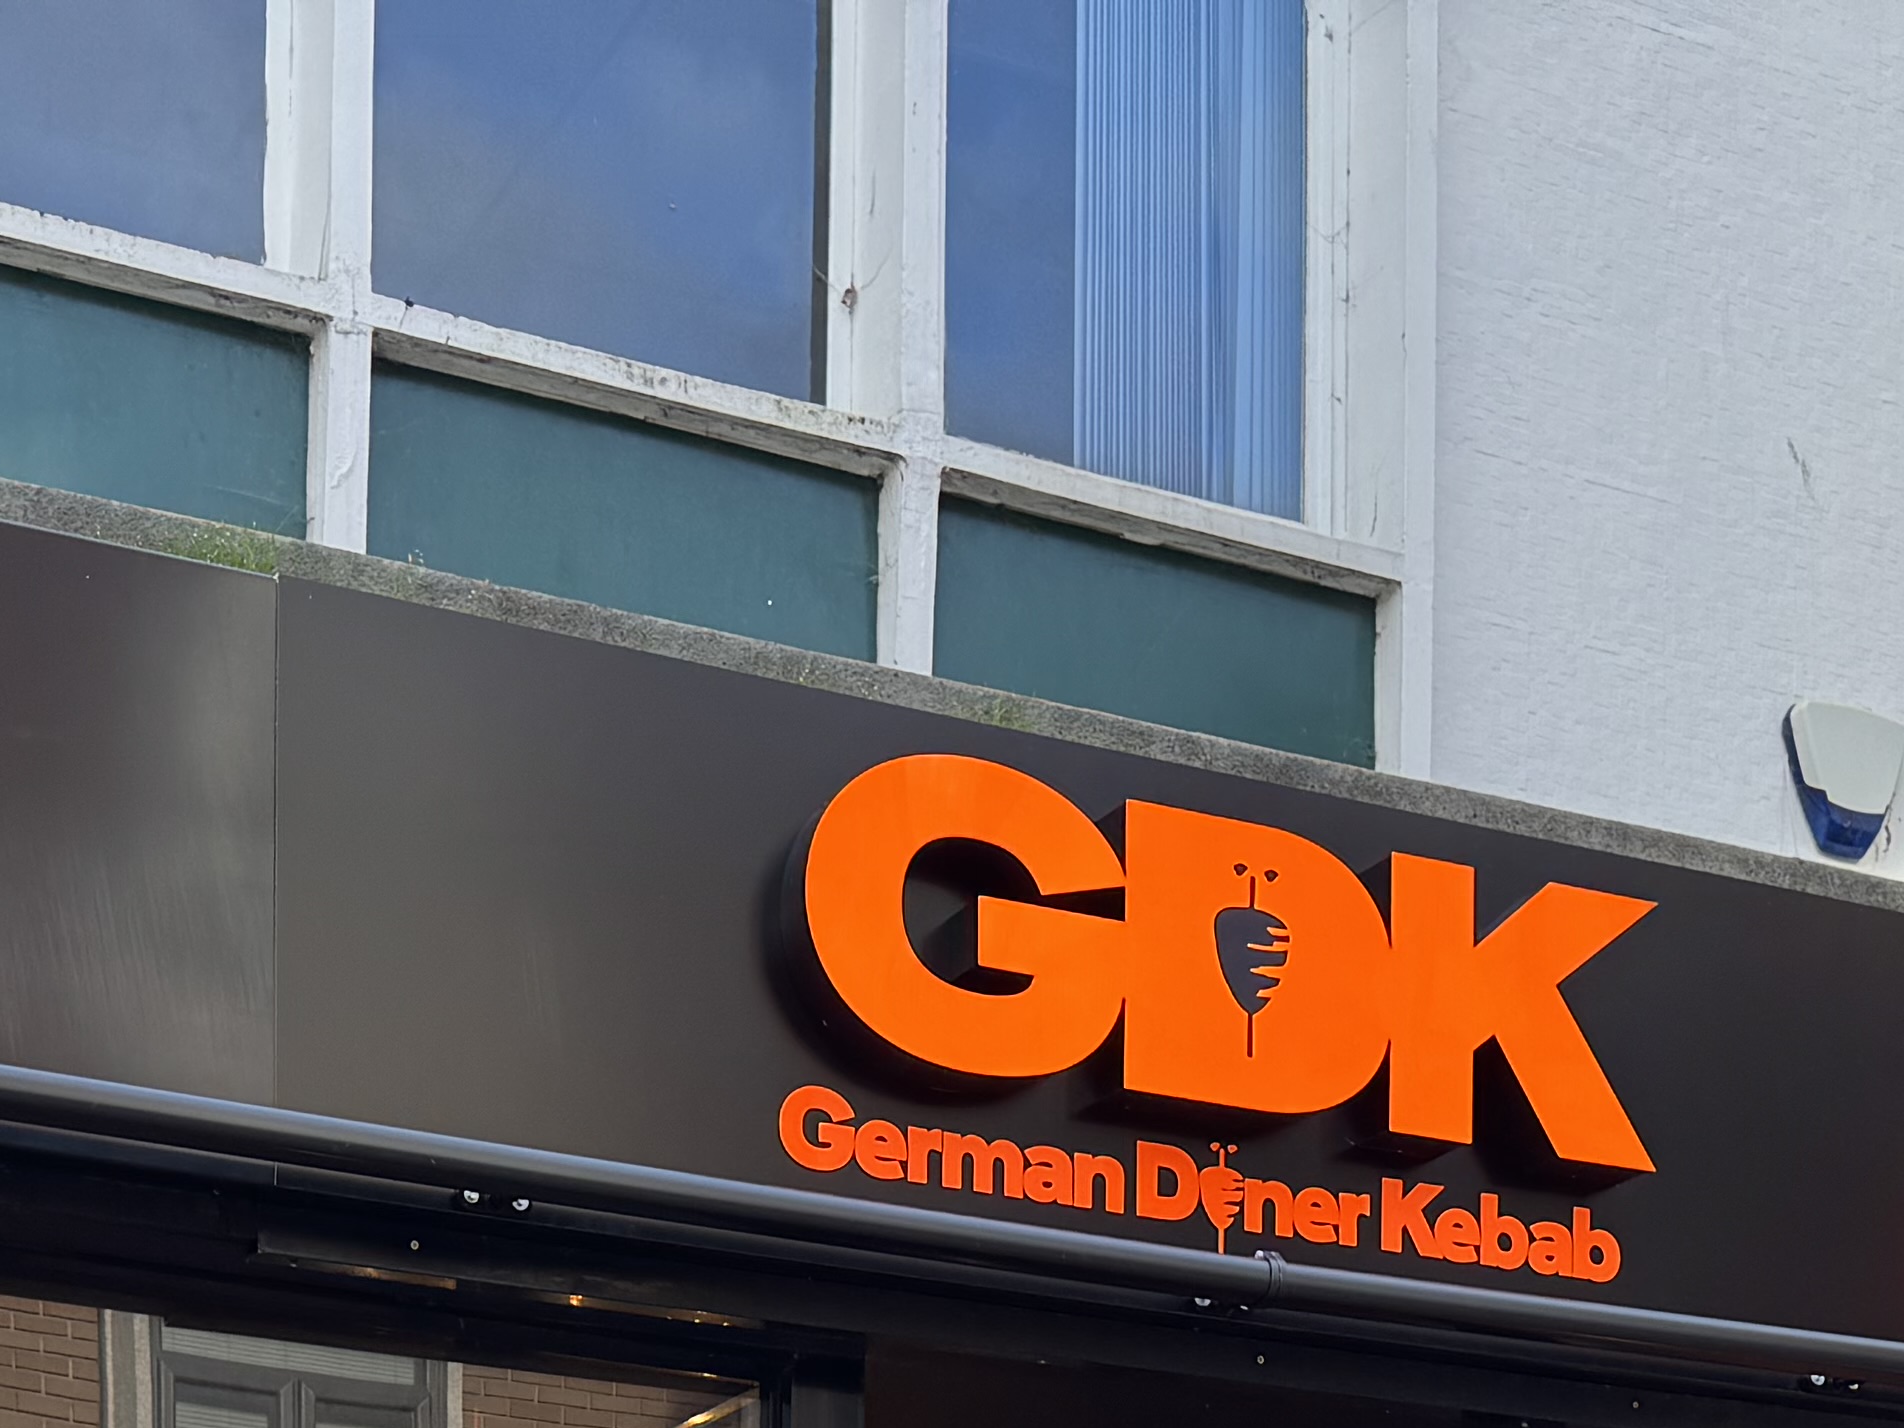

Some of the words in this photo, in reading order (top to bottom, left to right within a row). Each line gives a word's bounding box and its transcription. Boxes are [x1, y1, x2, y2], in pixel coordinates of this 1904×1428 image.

[806, 753, 1658, 1174] GDK
[779, 1085, 1124, 1214] German
[1380, 1177, 1621, 1283] Kebab
